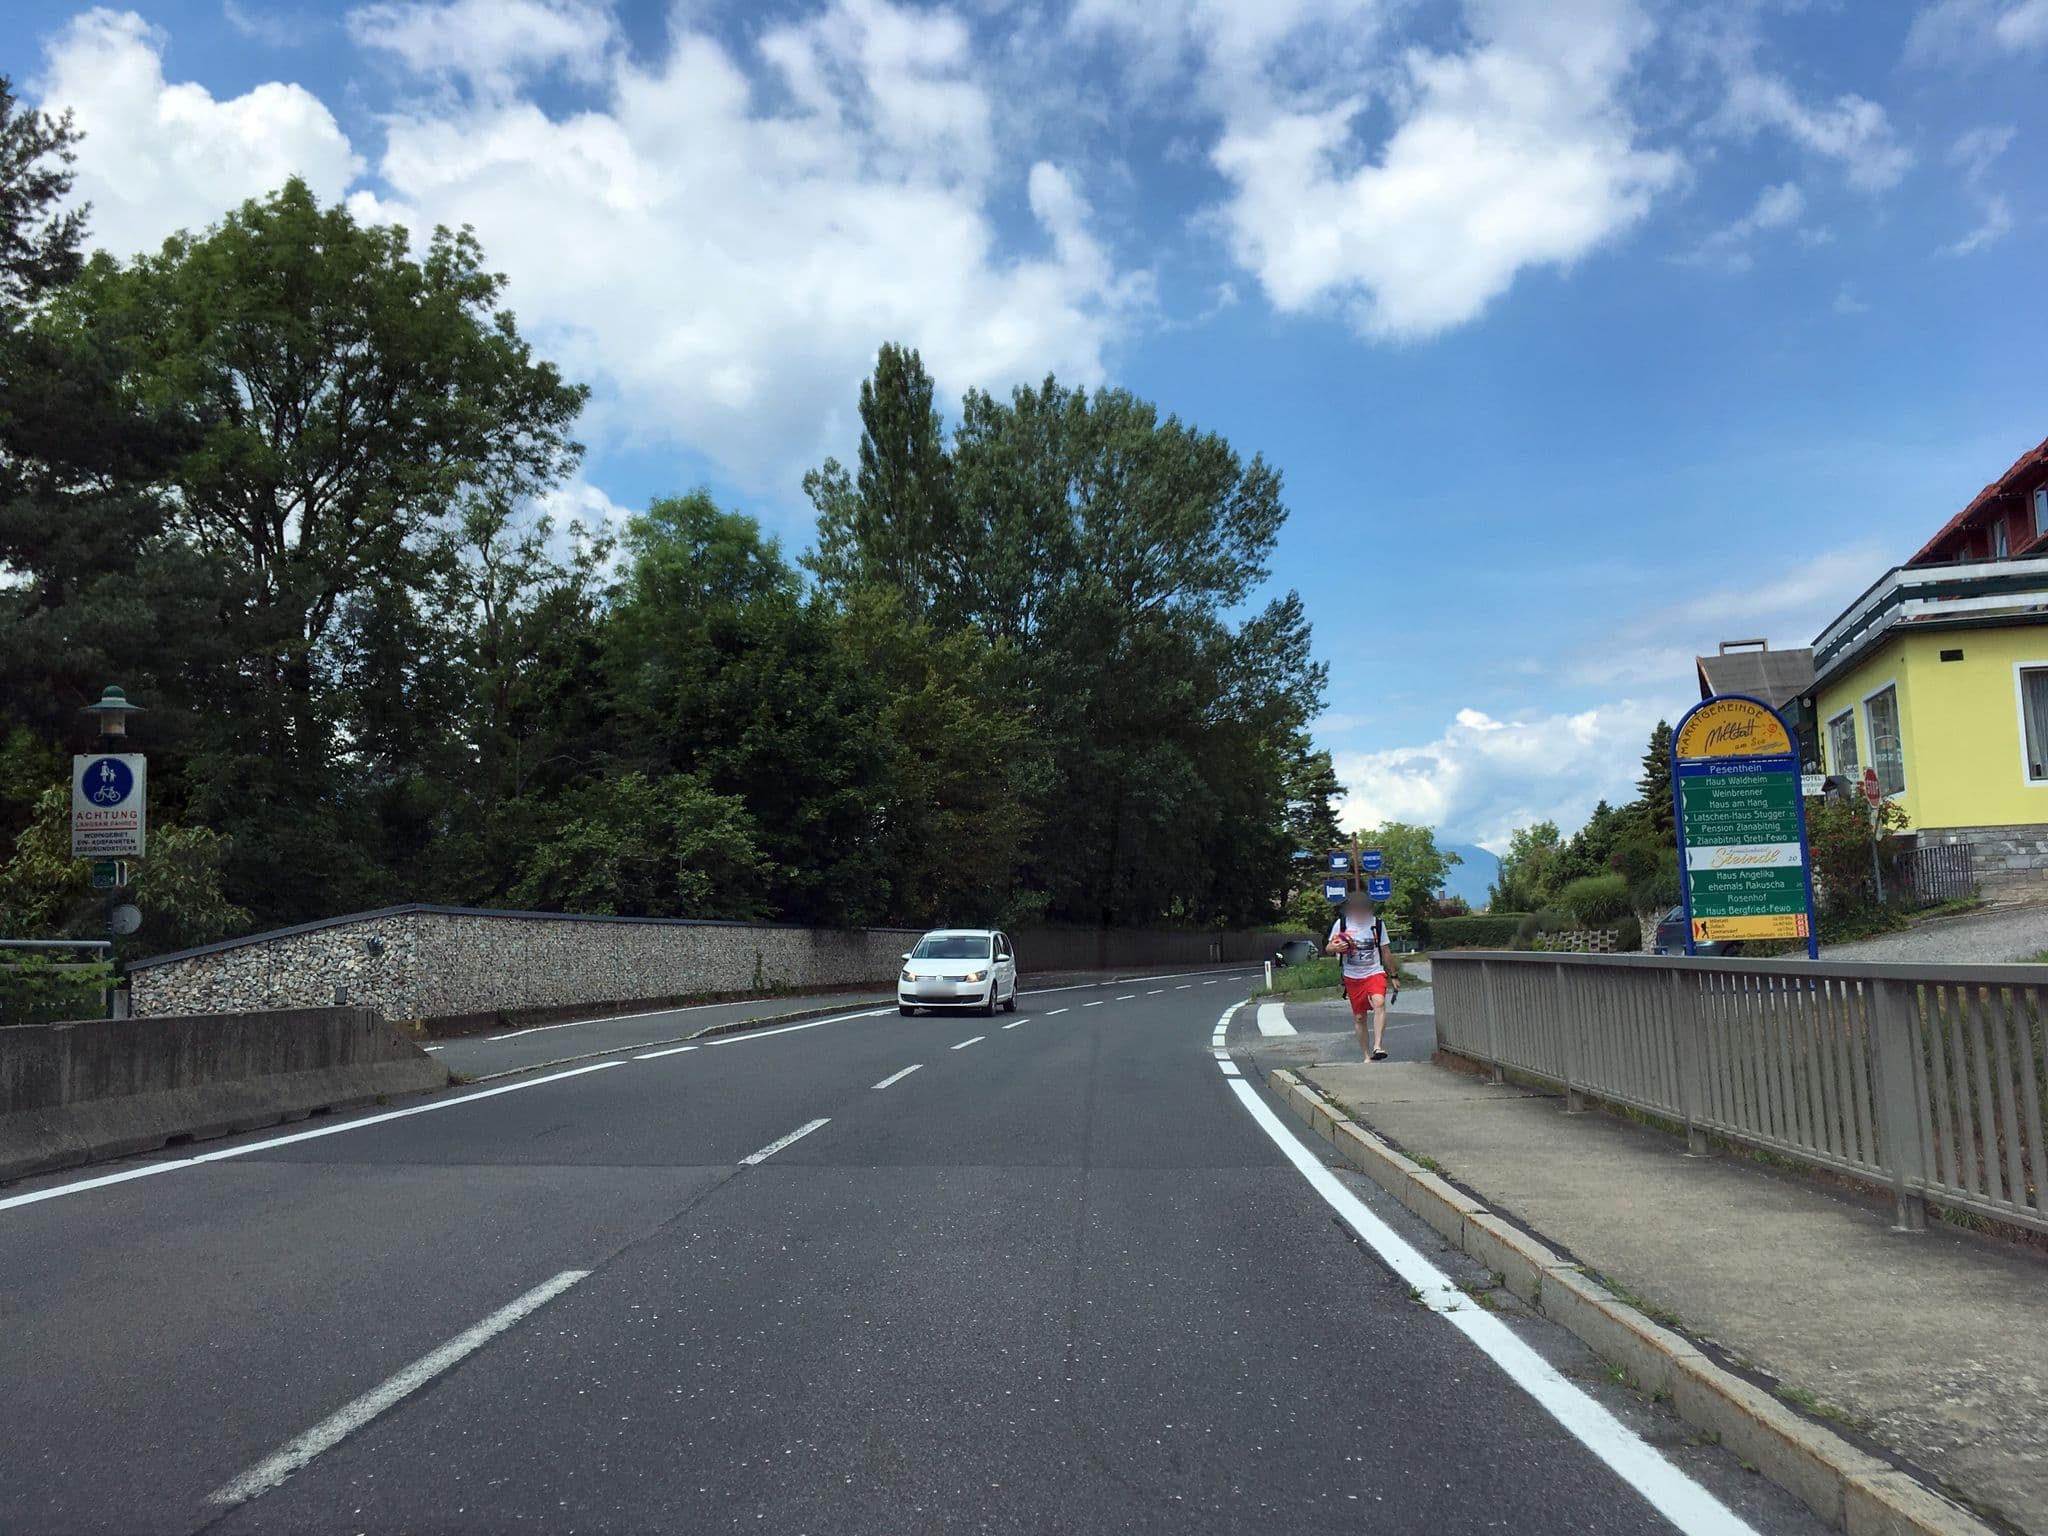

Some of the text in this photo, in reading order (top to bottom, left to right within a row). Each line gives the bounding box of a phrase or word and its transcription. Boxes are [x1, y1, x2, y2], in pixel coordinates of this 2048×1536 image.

[1680, 703, 1763, 755] MARKTGEMEINDE
[1704, 718, 1760, 754] Millstatt
[1710, 764, 1762, 774] Pesenthein
[1705, 775, 1768, 786] Haus Waldheim
[1711, 788, 1763, 798] Weinbrenner
[1709, 800, 1730, 809] Haus
[1747, 798, 1769, 809] Hang
[76, 811, 138, 820] ACHTUNG
[1693, 811, 1752, 822] Latschen-Haus
[1754, 810, 1786, 820] Stugger
[1701, 824, 1734, 833] Pension
[1711, 847, 1781, 869] Steindl
[1716, 870, 1775, 880] Haus Angelika
[1708, 881, 1744, 892] ehemals
[1727, 893, 1767, 903] Rosenhof
[1706, 907, 1727, 916] Haus
[1728, 904, 1792, 916] Bergfried-Fewo
